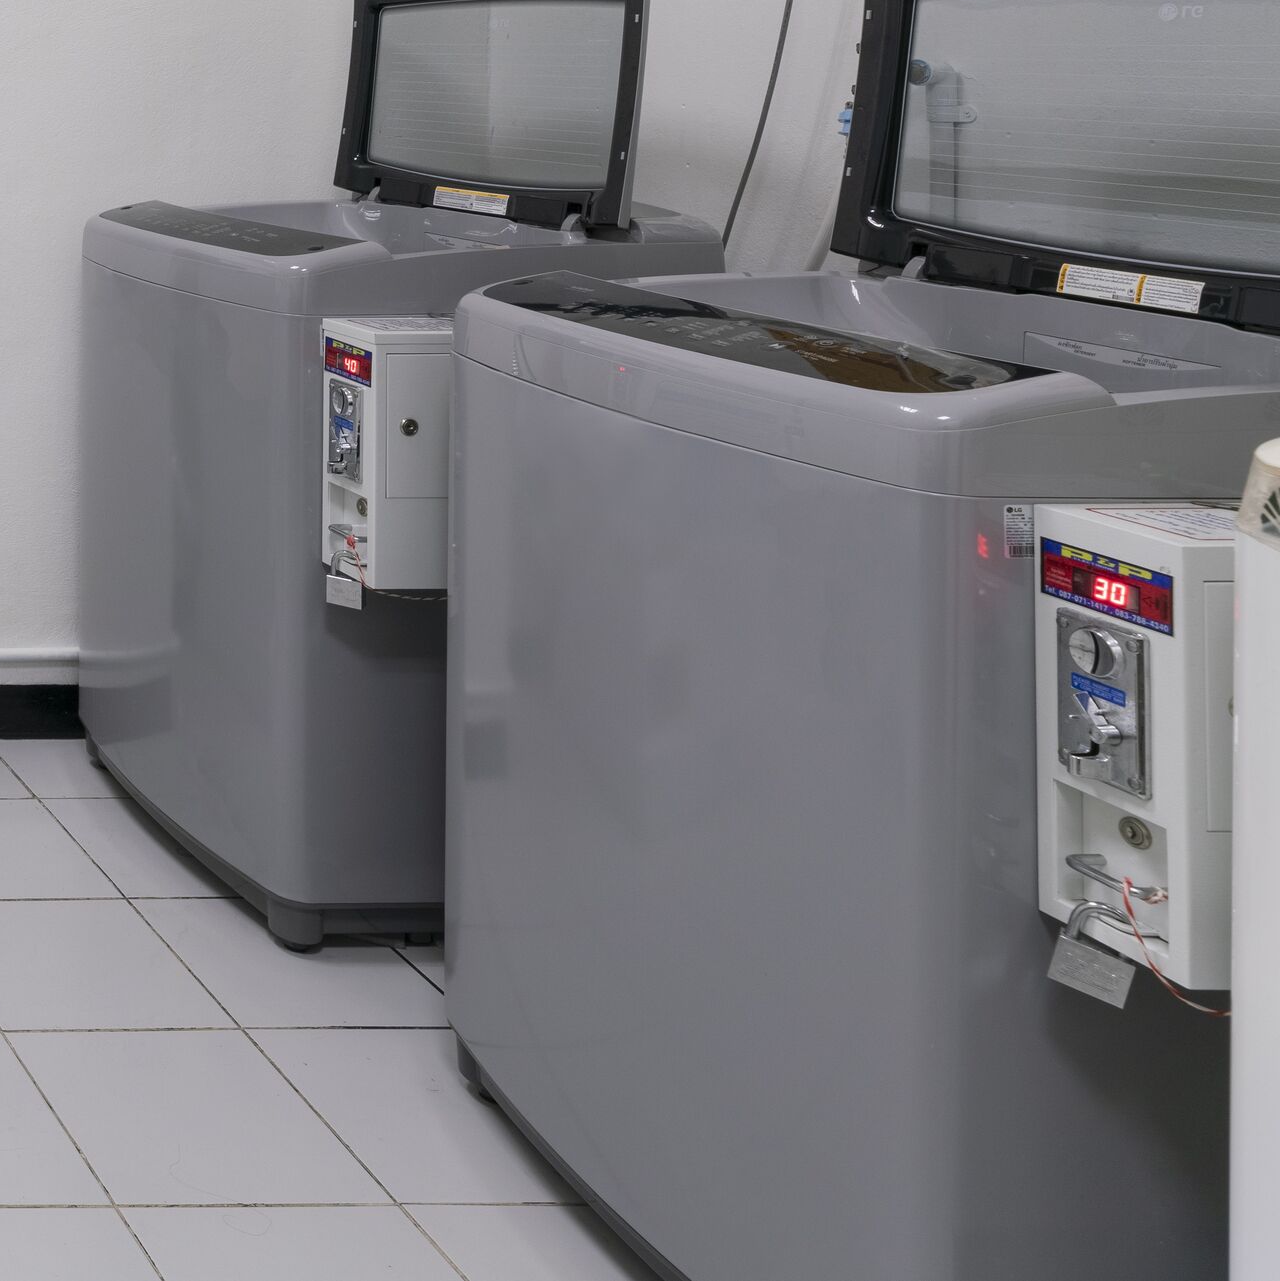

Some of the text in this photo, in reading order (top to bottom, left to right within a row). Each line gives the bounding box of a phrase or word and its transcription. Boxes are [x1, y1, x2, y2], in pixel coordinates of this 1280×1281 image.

[344, 358, 357, 373] 40
[1045, 585, 1057, 595] Tel.
[1094, 577, 1126, 605] 30
